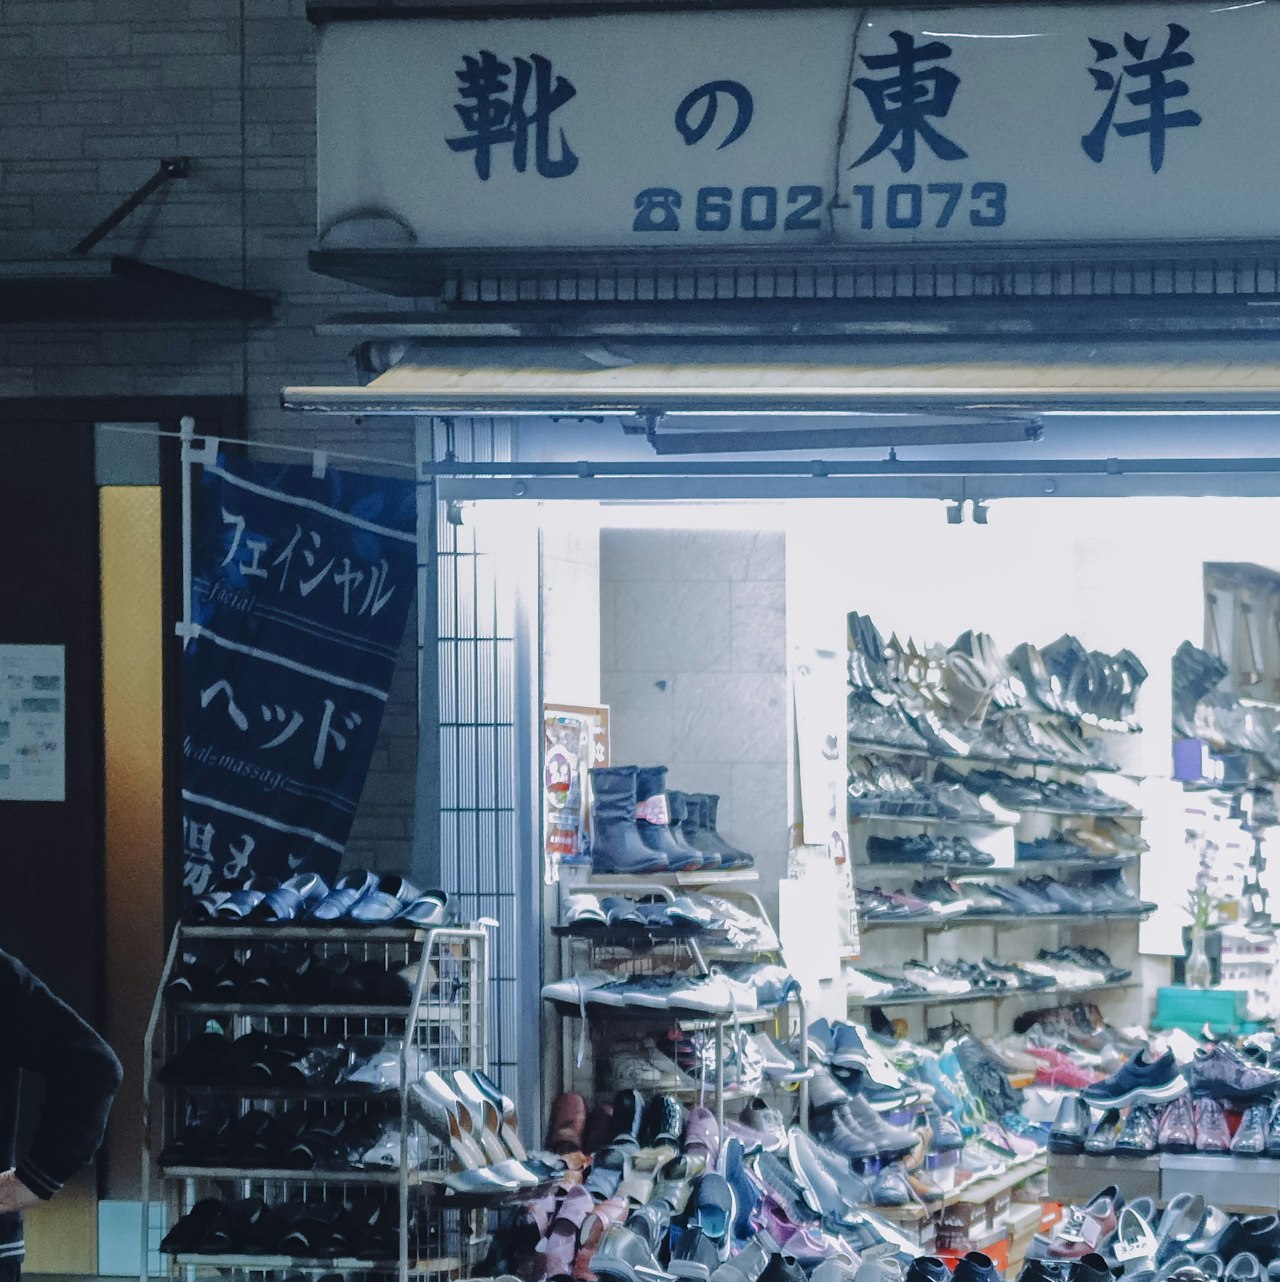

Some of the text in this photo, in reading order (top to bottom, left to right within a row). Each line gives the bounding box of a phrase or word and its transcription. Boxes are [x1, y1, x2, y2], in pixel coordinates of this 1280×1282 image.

[445, 22, 1204, 180] 靴の東洋
[693, 182, 1009, 232] 602-1073
[219, 505, 397, 619] フェイシャル
[199, 676, 364, 771] ヘッド
